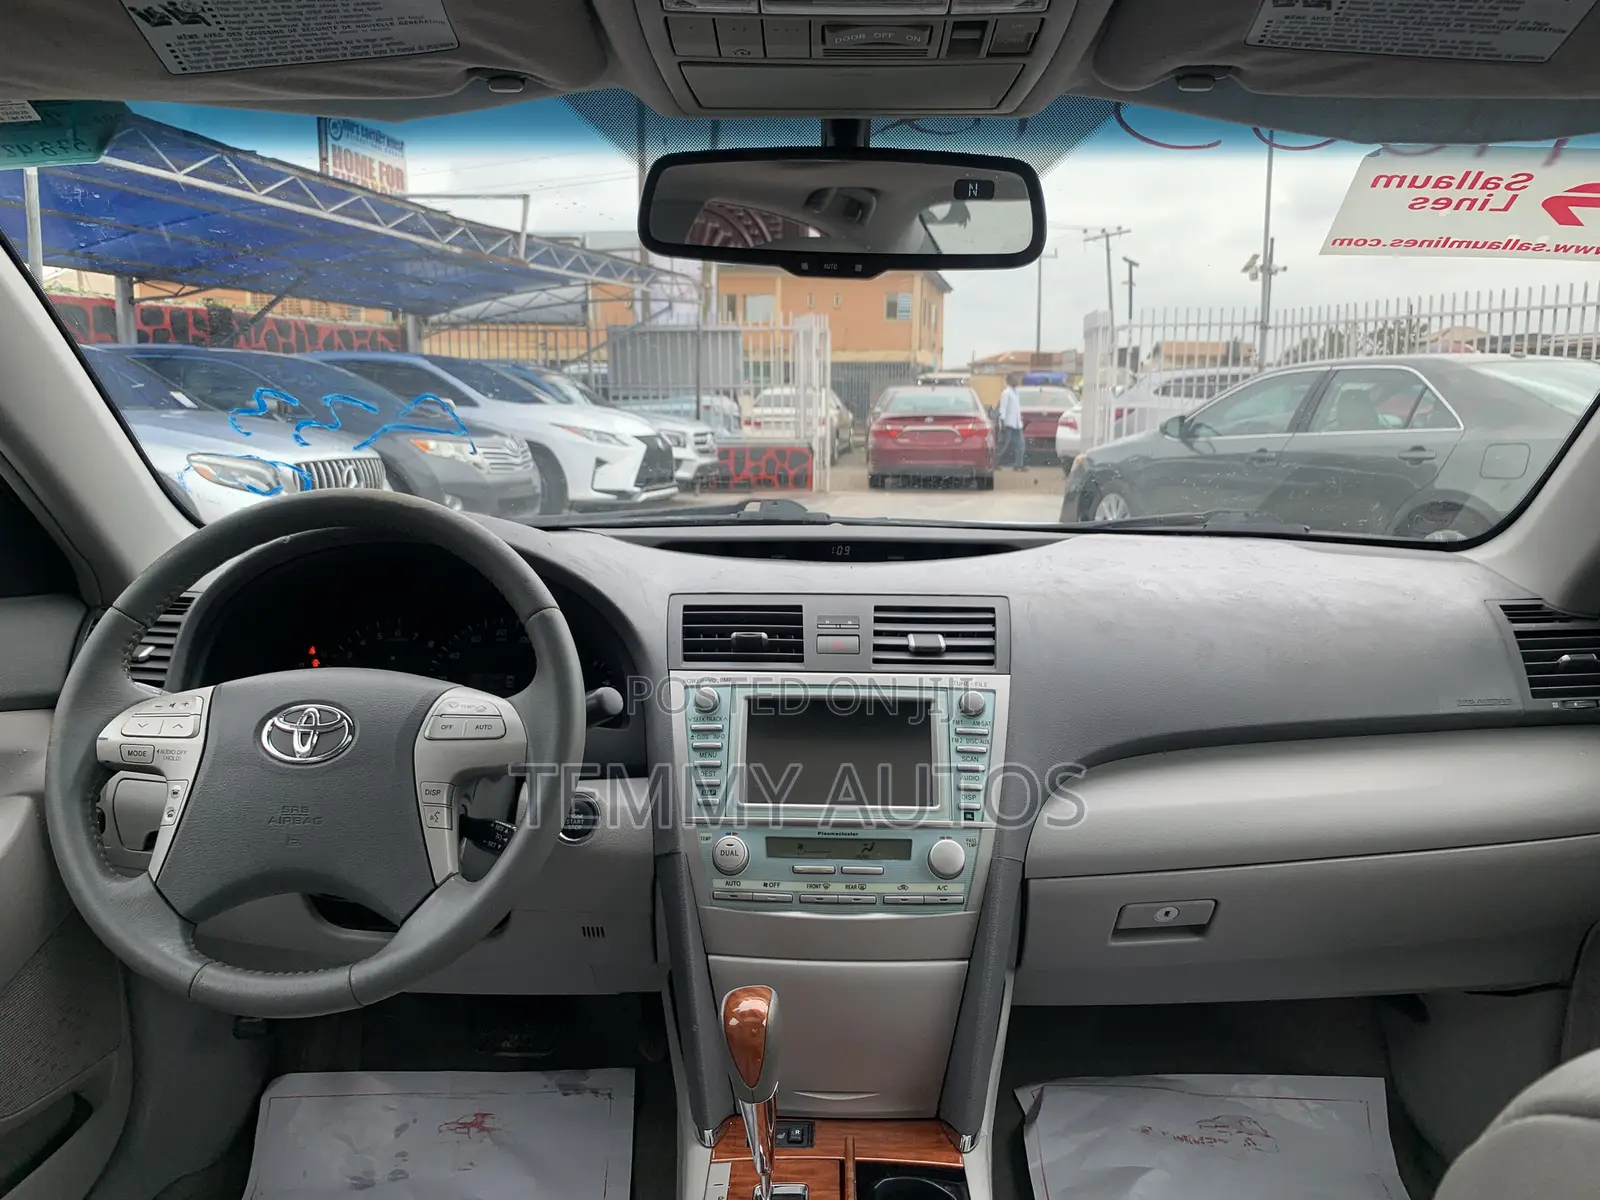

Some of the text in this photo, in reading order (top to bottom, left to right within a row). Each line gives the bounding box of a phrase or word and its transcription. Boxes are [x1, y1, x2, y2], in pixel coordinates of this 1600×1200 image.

[835, 33, 867, 44] DOOR
[331, 143, 376, 181] HOME
[378, 160, 405, 192] FOR
[967, 183, 979, 198] N
[127, 750, 147, 758] MODE
[424, 788, 441, 797] DISP
[267, 816, 323, 825] AIRBAG
